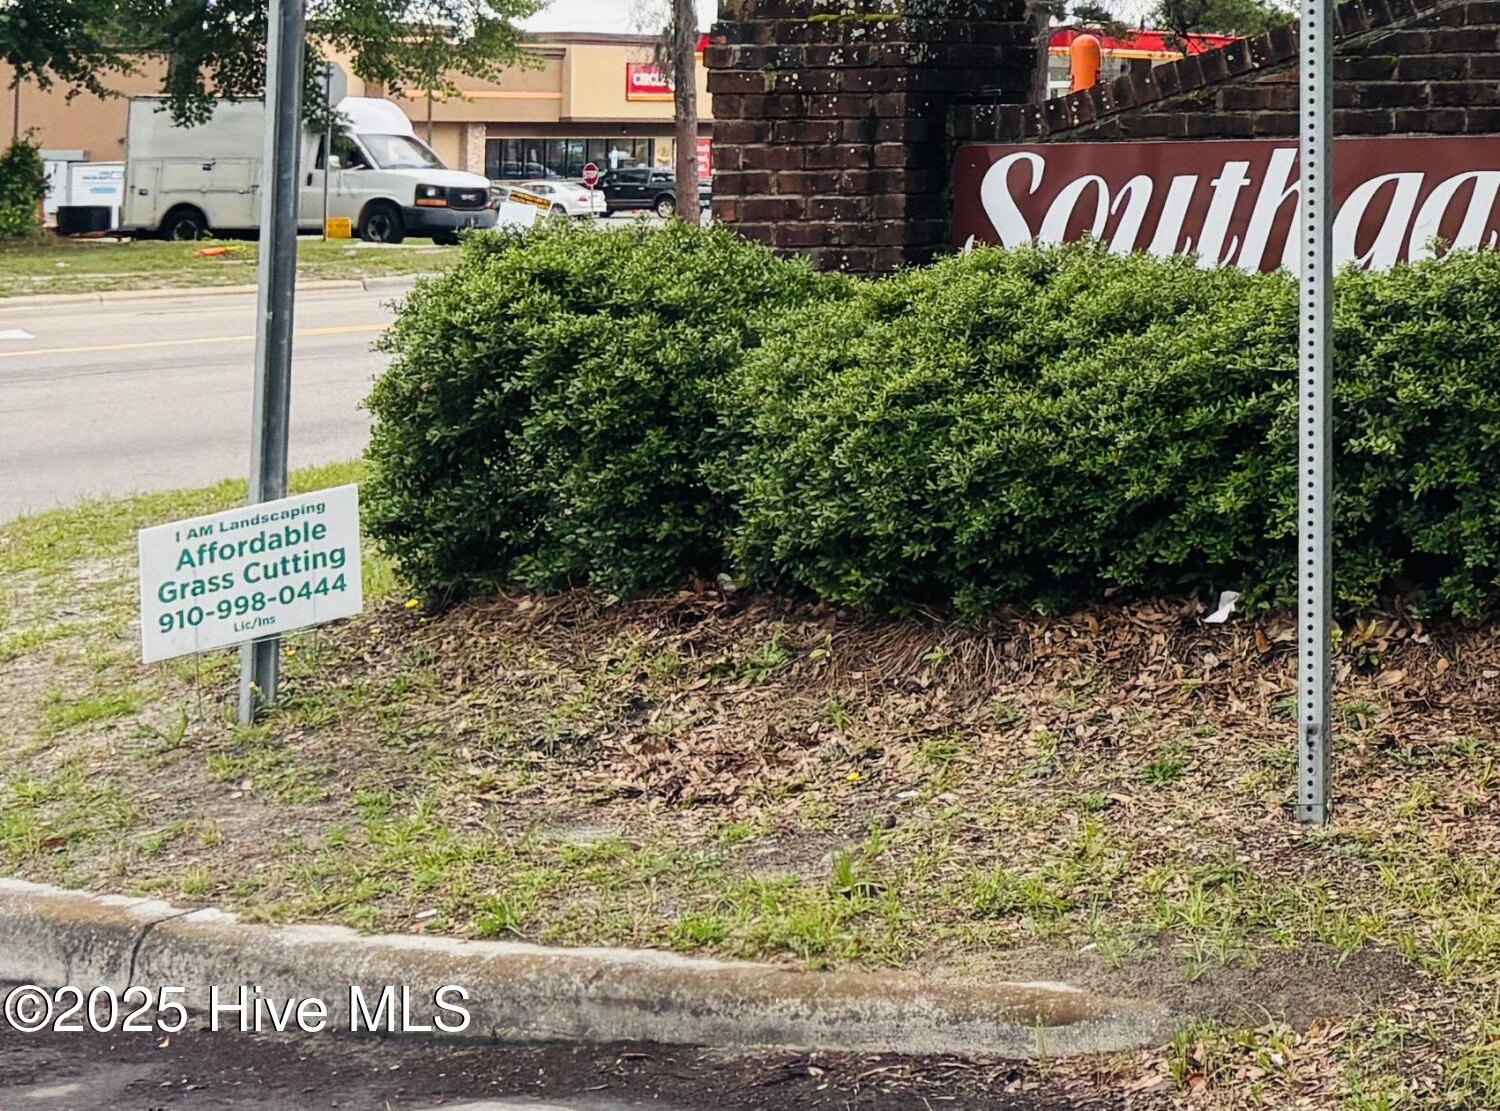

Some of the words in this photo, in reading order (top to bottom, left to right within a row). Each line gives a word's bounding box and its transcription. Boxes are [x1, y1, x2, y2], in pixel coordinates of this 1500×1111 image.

[175, 530, 181, 543] I
[186, 524, 214, 540] AM
[219, 502, 326, 534] Landscaping
[176, 521, 327, 572] Affordable
[158, 572, 235, 604] Grass
[243, 546, 346, 584] Cutting
[158, 573, 347, 634] 910-998-0444
[233, 614, 276, 633] Lic/Ins
